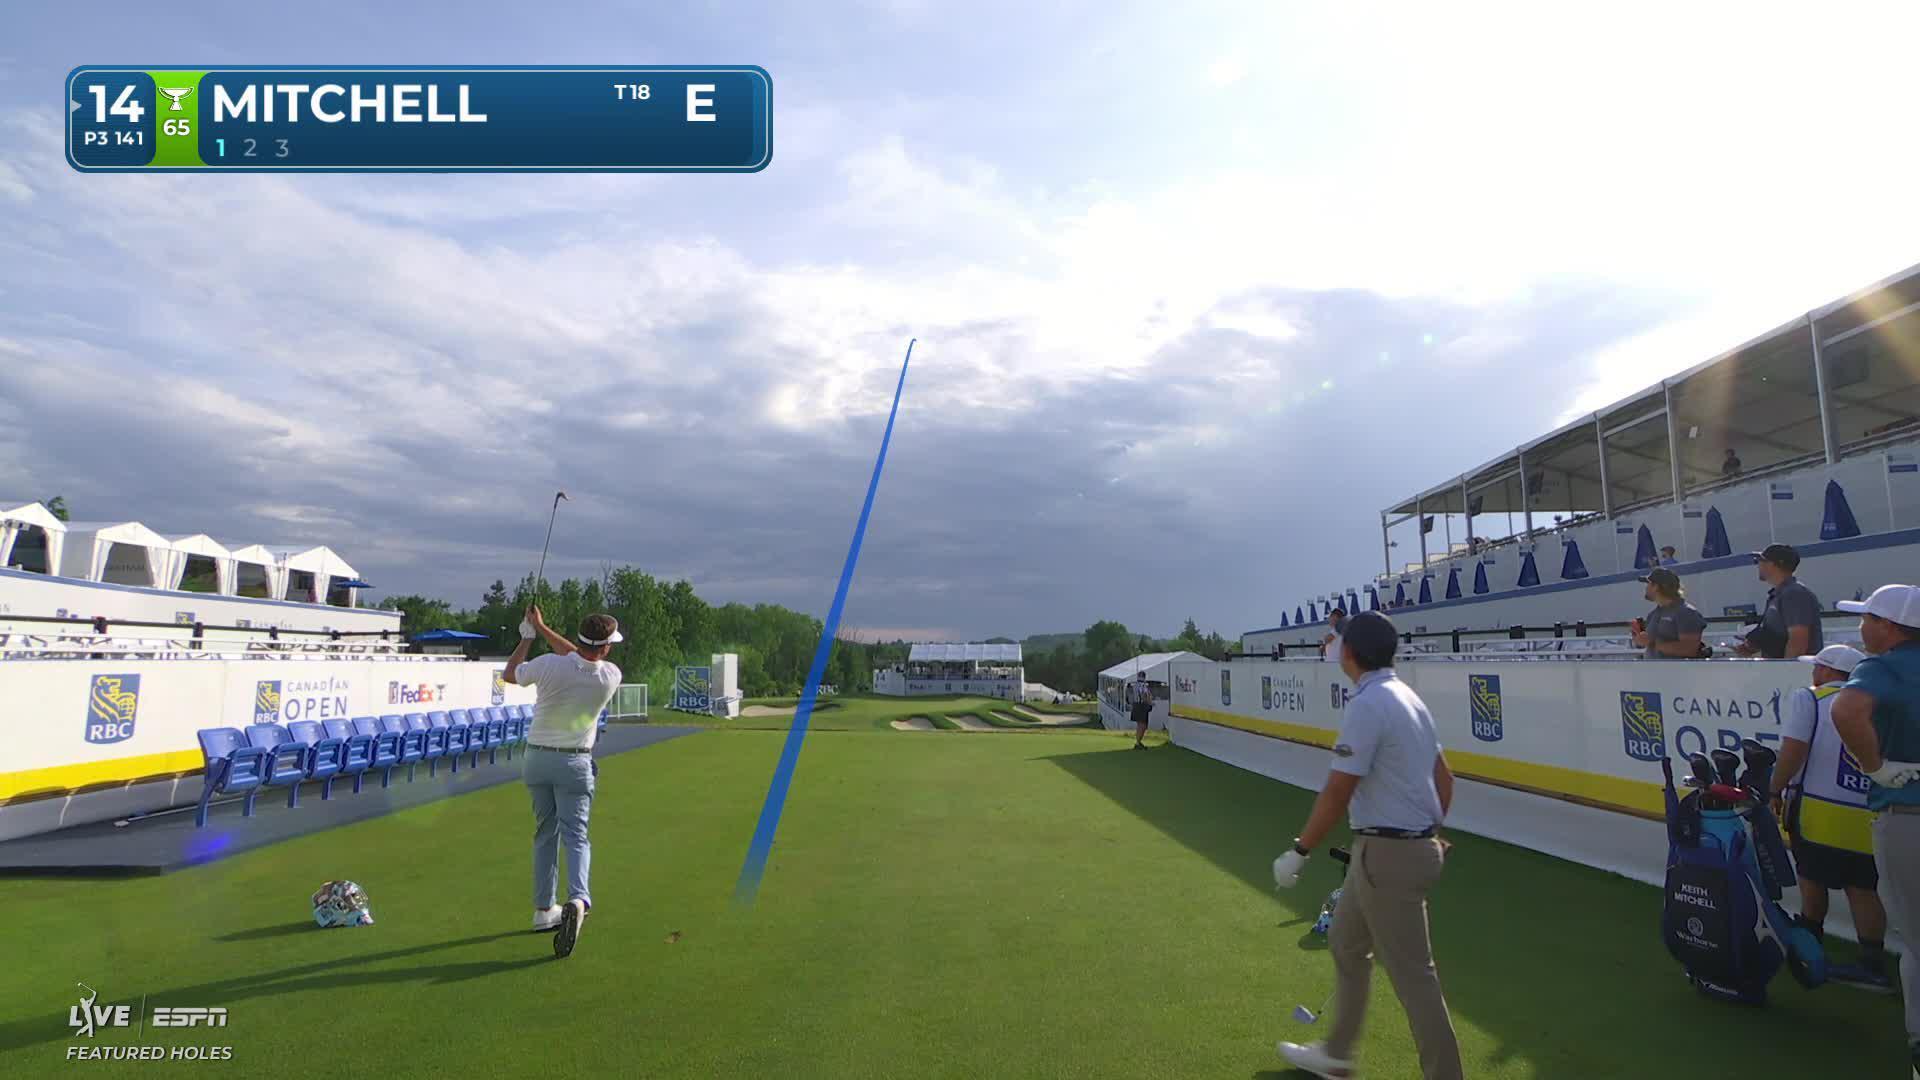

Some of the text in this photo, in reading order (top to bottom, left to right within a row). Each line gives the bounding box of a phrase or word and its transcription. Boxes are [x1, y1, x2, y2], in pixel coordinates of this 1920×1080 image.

[287, 678, 349, 693] CANADIAN
[400, 683, 433, 704] FedEx
[815, 684, 839, 696] RBC
[285, 696, 348, 721] OPEN
[679, 696, 708, 708] RBC
[1273, 690, 1305, 712] OPEN
[1673, 694, 1781, 724] CANADI
[256, 711, 278, 724] RBC
[90, 721, 132, 741] RBC
[1474, 721, 1502, 739] RBC
[1628, 739, 1663, 758] RBC
[1842, 773, 1871, 790] RB
[1681, 883, 1709, 897] KEITH
[1673, 891, 1718, 910] MITCHELL
